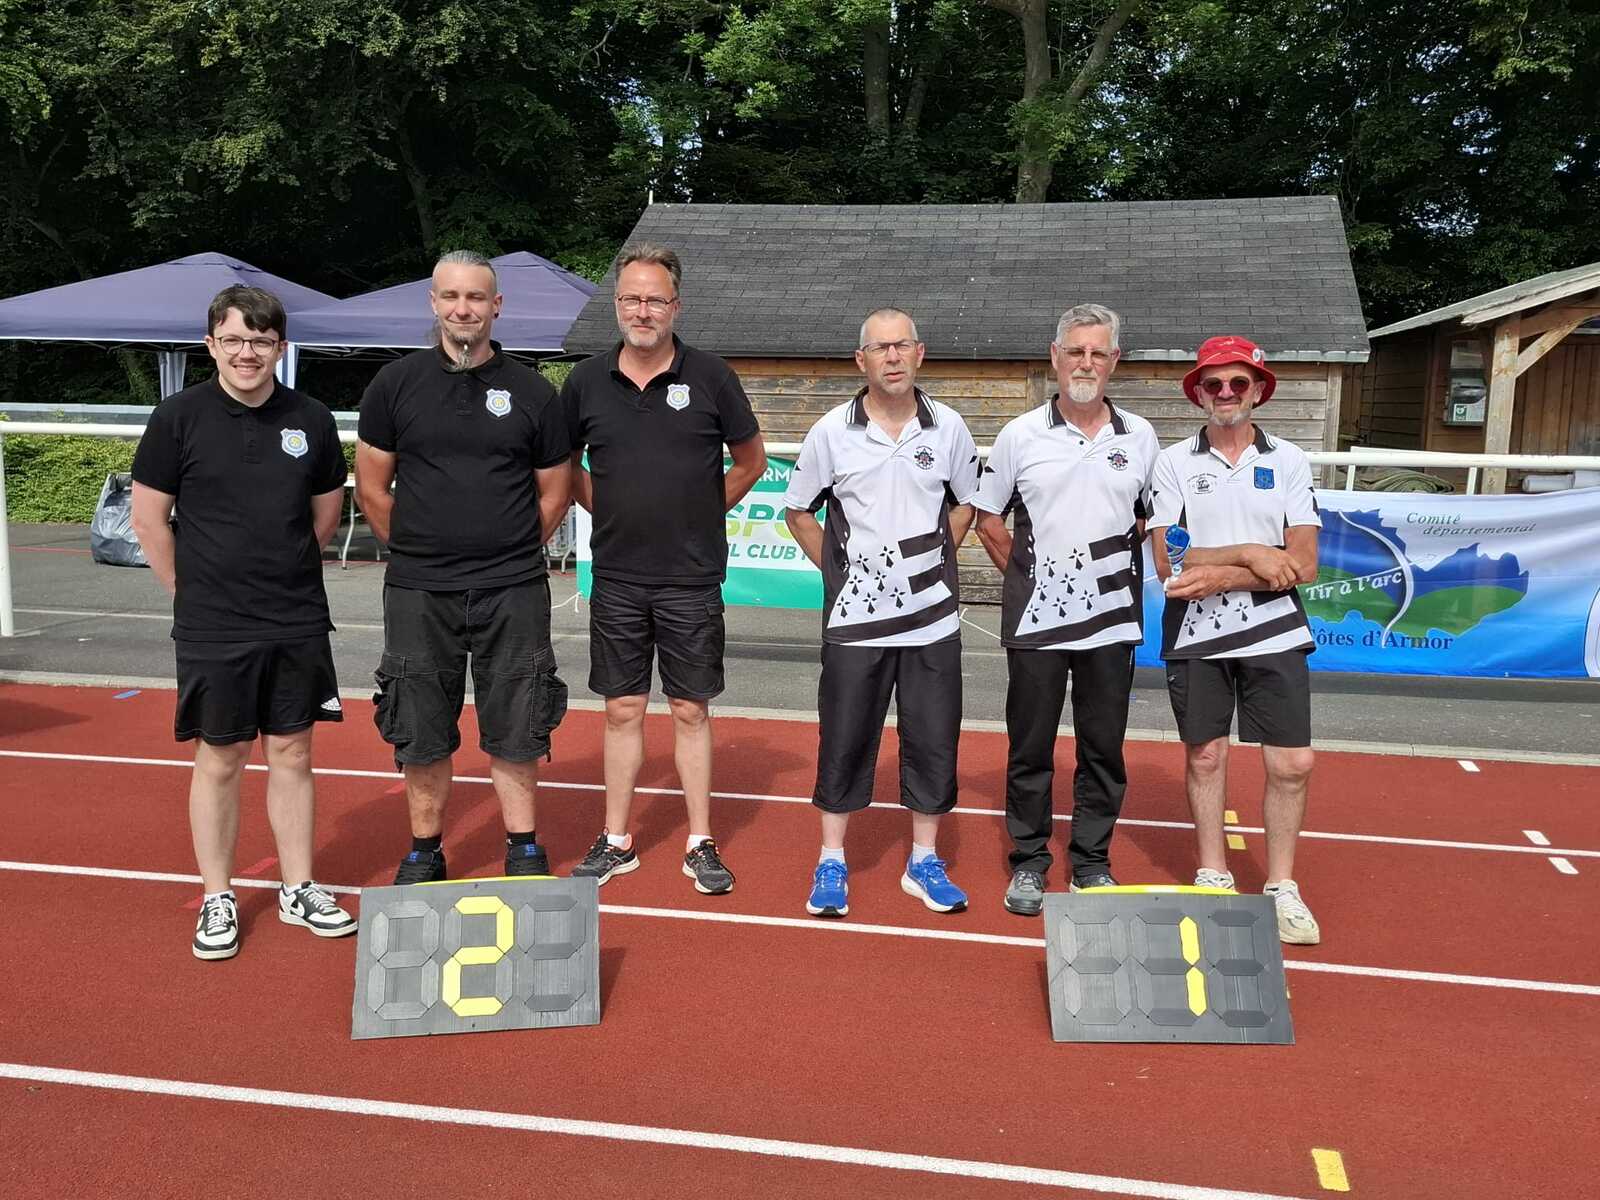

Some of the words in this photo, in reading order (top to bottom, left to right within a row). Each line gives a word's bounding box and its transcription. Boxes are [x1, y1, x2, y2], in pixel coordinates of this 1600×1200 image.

[759, 467, 790, 482] RM
[1406, 512, 1461, 525] Comité
[1423, 523, 1536, 536] départemental
[747, 544, 797, 560] CLUB
[1306, 585, 1333, 601] Tir
[1340, 580, 1352, 595] à
[1358, 572, 1402, 591] l'arc
[1312, 628, 1354, 647] ôtes
[1362, 630, 1454, 650] d'Armor
[442, 896, 514, 1017] 2
